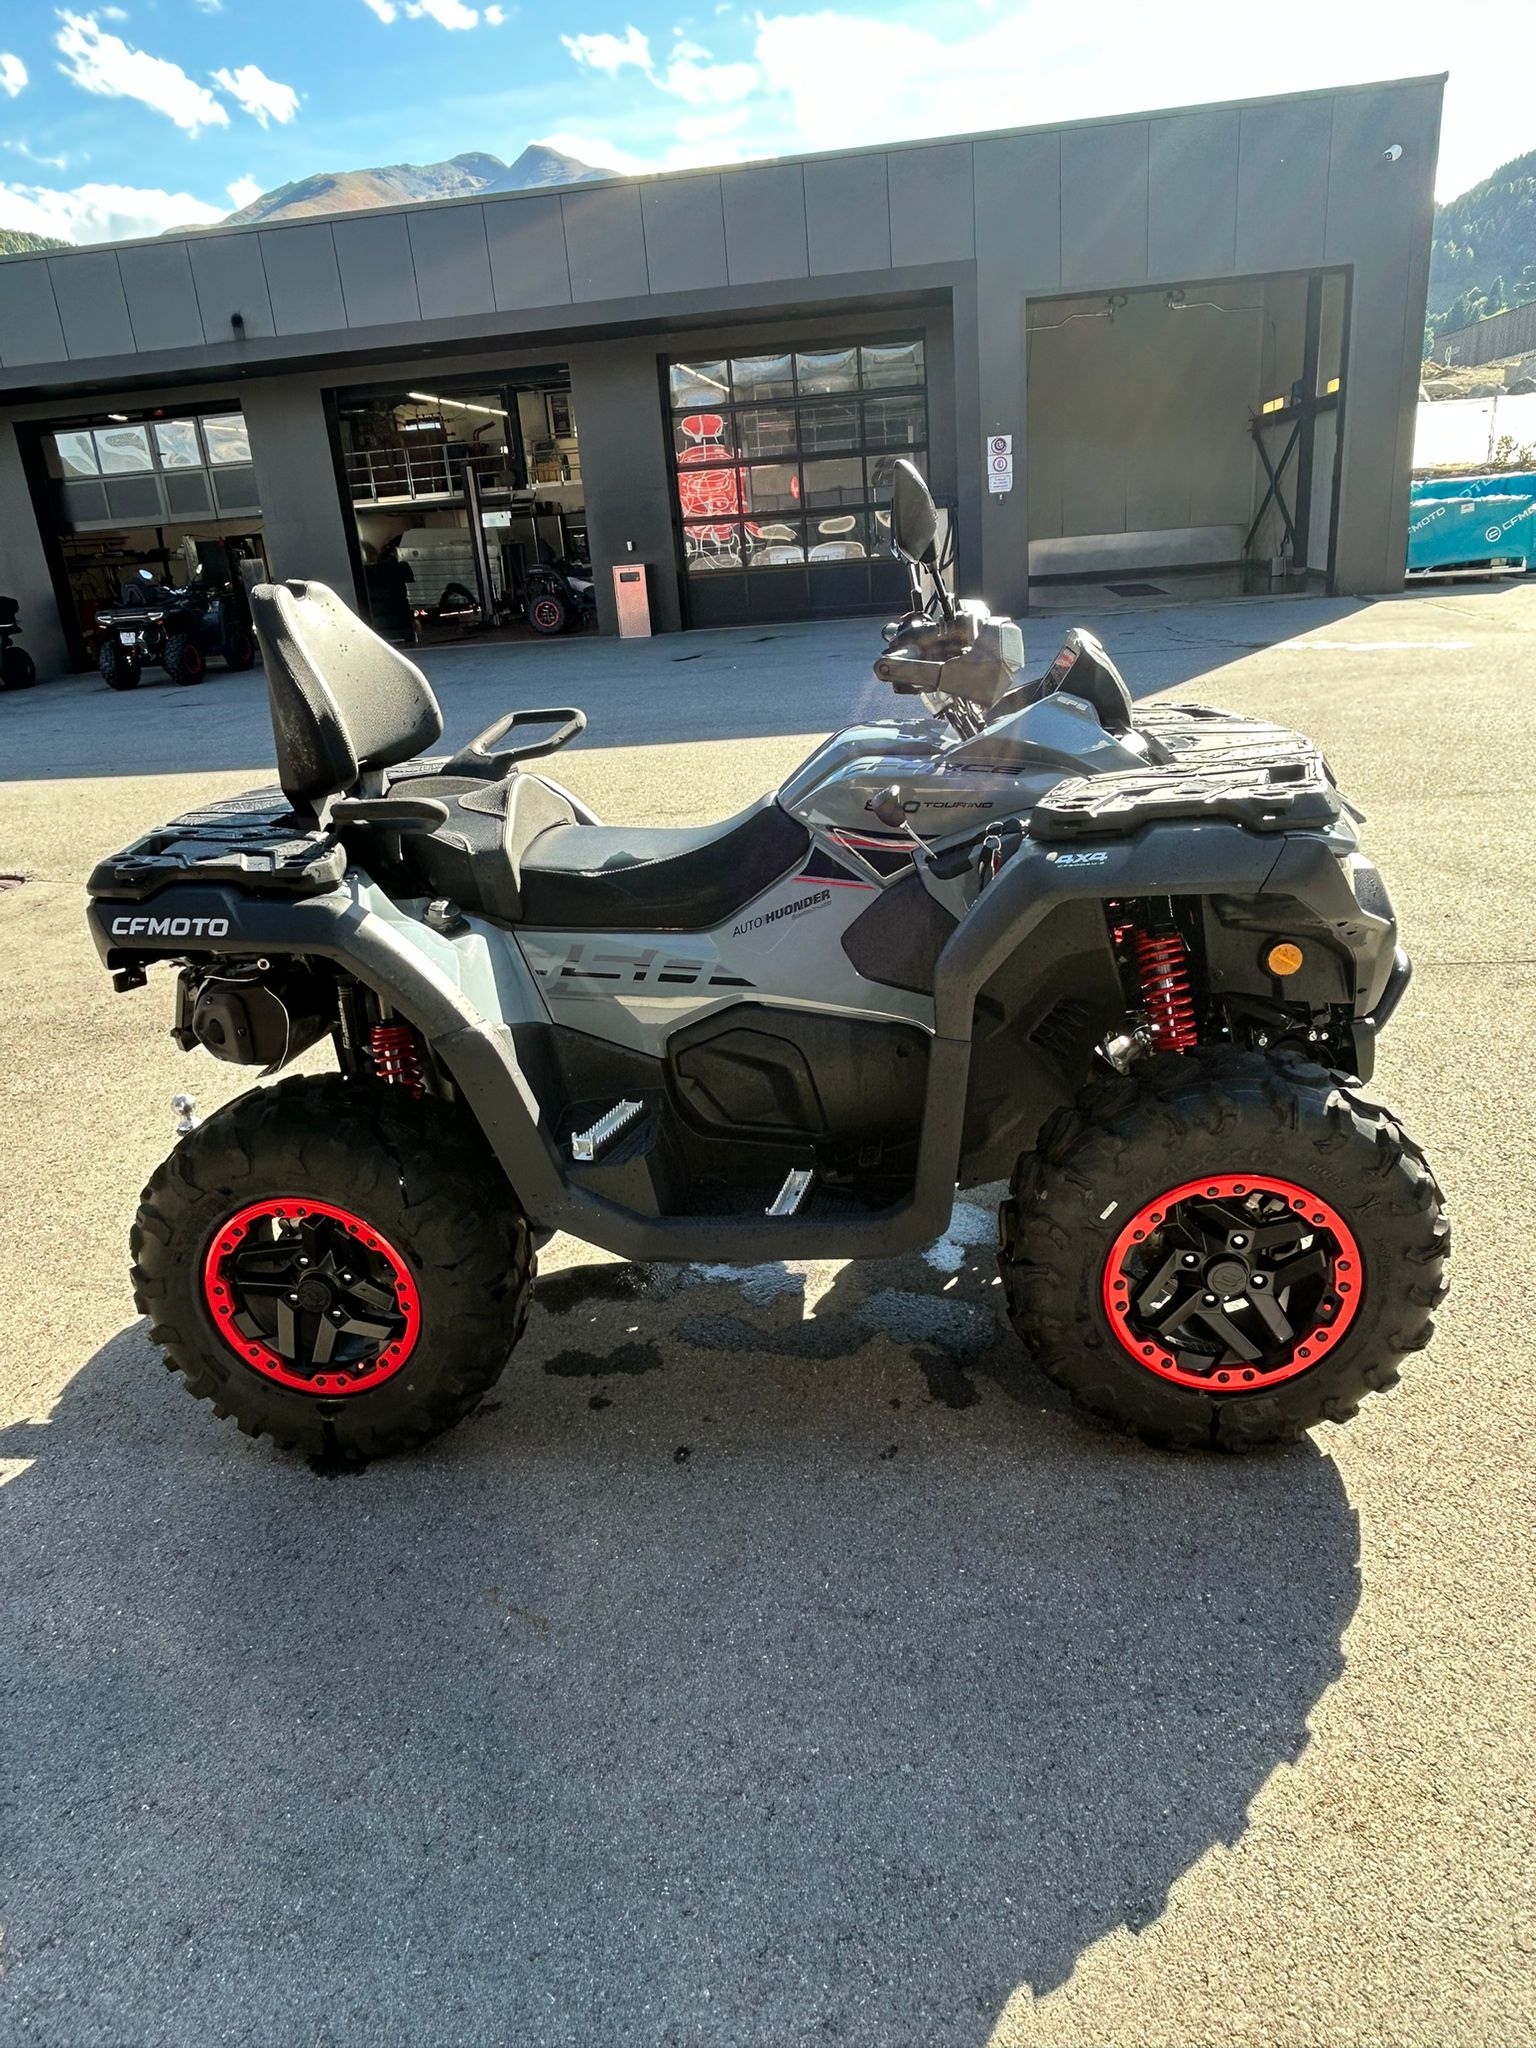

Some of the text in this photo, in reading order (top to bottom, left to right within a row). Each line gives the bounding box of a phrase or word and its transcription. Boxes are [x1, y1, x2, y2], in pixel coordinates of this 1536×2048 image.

[923, 801, 994, 809] TOURING
[732, 917, 763, 938] AUTO
[765, 888, 831, 925] HUONDER
[111, 916, 229, 937] CFMOTO
